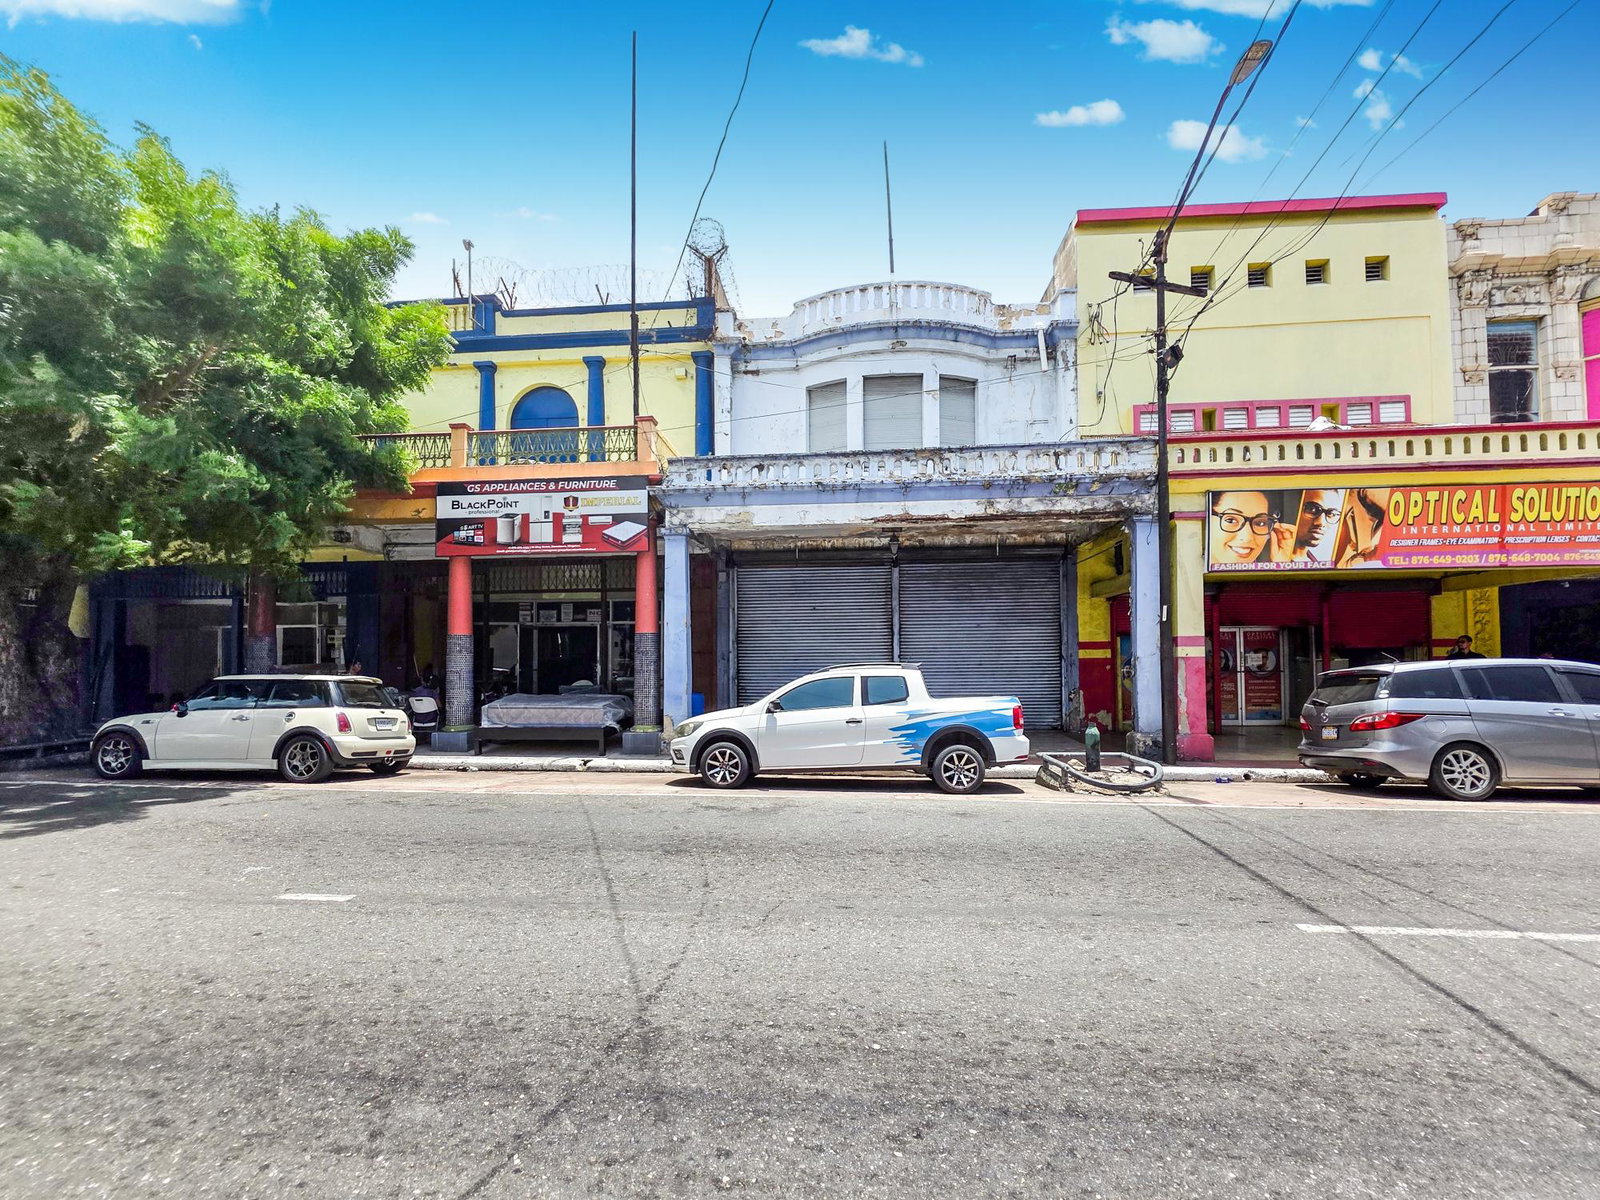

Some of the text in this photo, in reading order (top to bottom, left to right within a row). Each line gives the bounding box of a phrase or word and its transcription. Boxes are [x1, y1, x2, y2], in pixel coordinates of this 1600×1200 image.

[467, 480, 617, 492] GS APPLIANCES & FURNITURE
[1388, 486, 1600, 526] OPTICAL SOLUTIO
[1402, 523, 1536, 534] INTERNATIONAL
[1390, 539, 1418, 547] DESIGNER
[1419, 538, 1443, 546] FRAMES
[1458, 537, 1499, 545] EXAMINATION
[1503, 536, 1546, 544] PRESCRIPTION
[1547, 535, 1570, 543] LENSES
[1388, 556, 1409, 565] TEL:
[1411, 554, 1480, 565] 876-649-0203
[1214, 561, 1332, 570] FASHION FOR YOUR FACE
